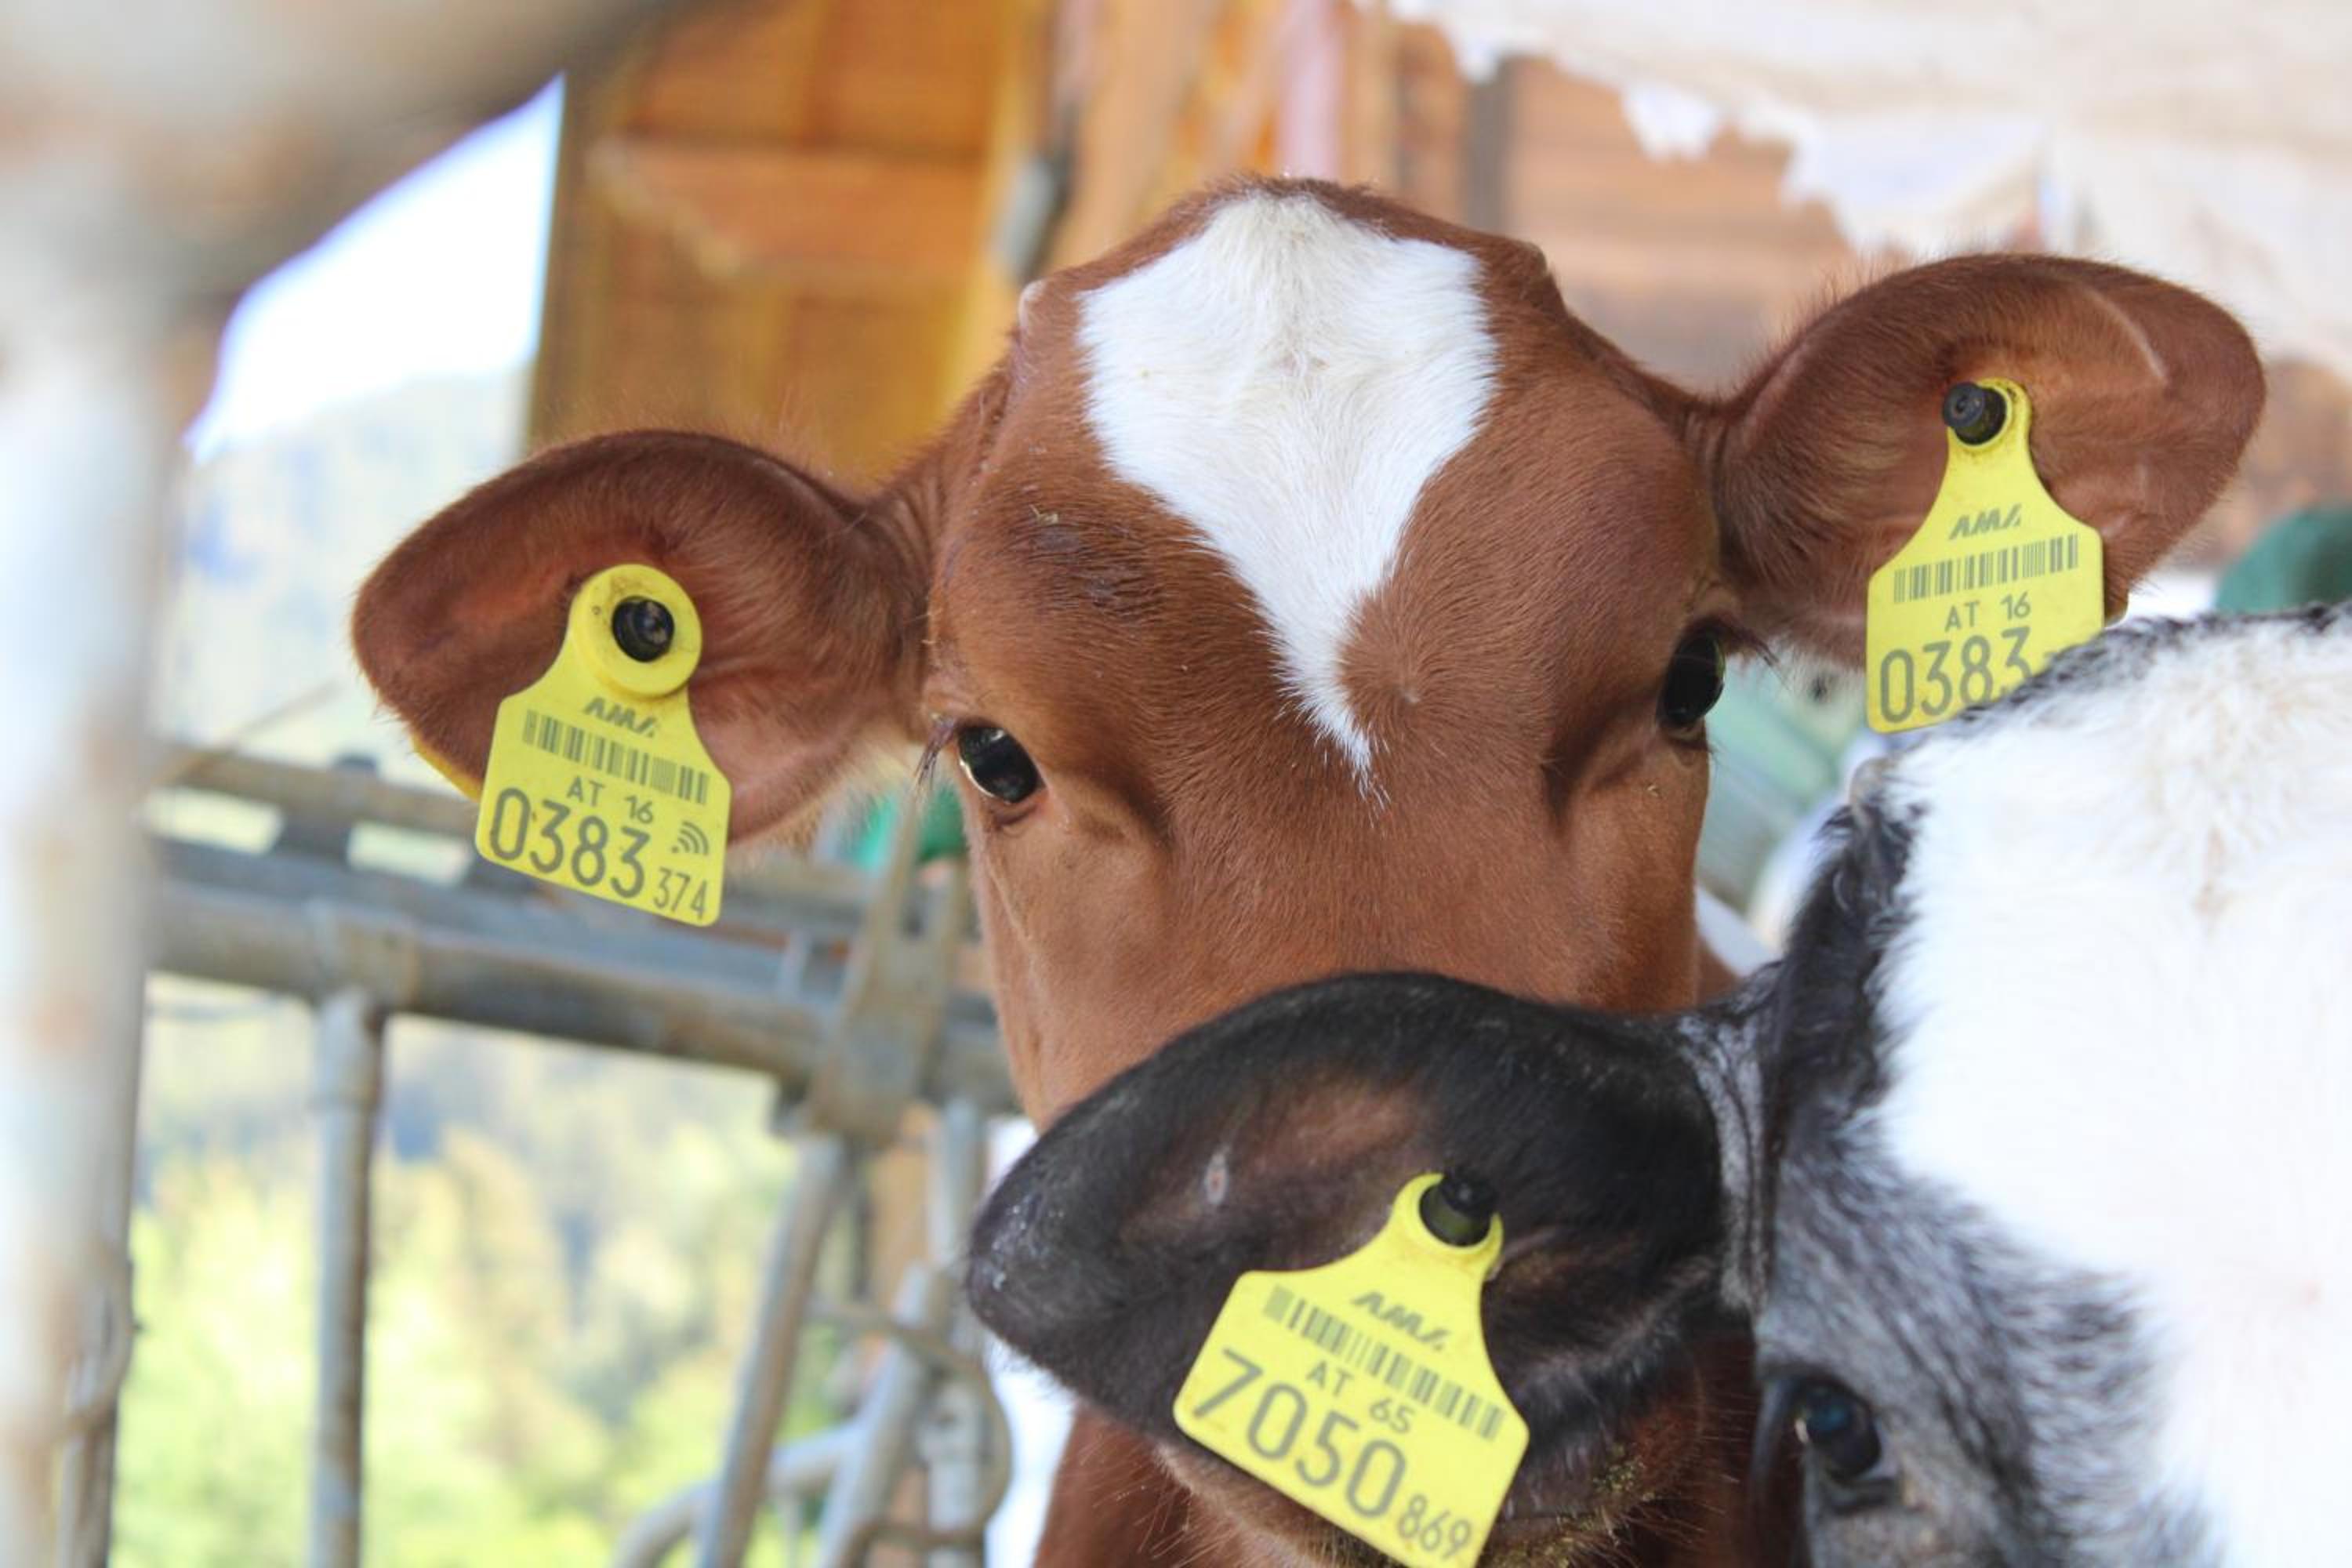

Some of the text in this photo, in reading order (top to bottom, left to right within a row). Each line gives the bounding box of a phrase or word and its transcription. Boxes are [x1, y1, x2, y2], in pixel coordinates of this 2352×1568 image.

[1949, 504, 2022, 540] AMA
[1944, 591, 2031, 633] AT 16
[583, 698, 661, 738] AMA
[566, 776, 655, 825] AT 16
[490, 788, 708, 920] 0383 374
[1351, 1292, 1450, 1351] AMA
[1306, 1361, 1415, 1435] AT 65
[1193, 1348, 1473, 1561] 7050 869
